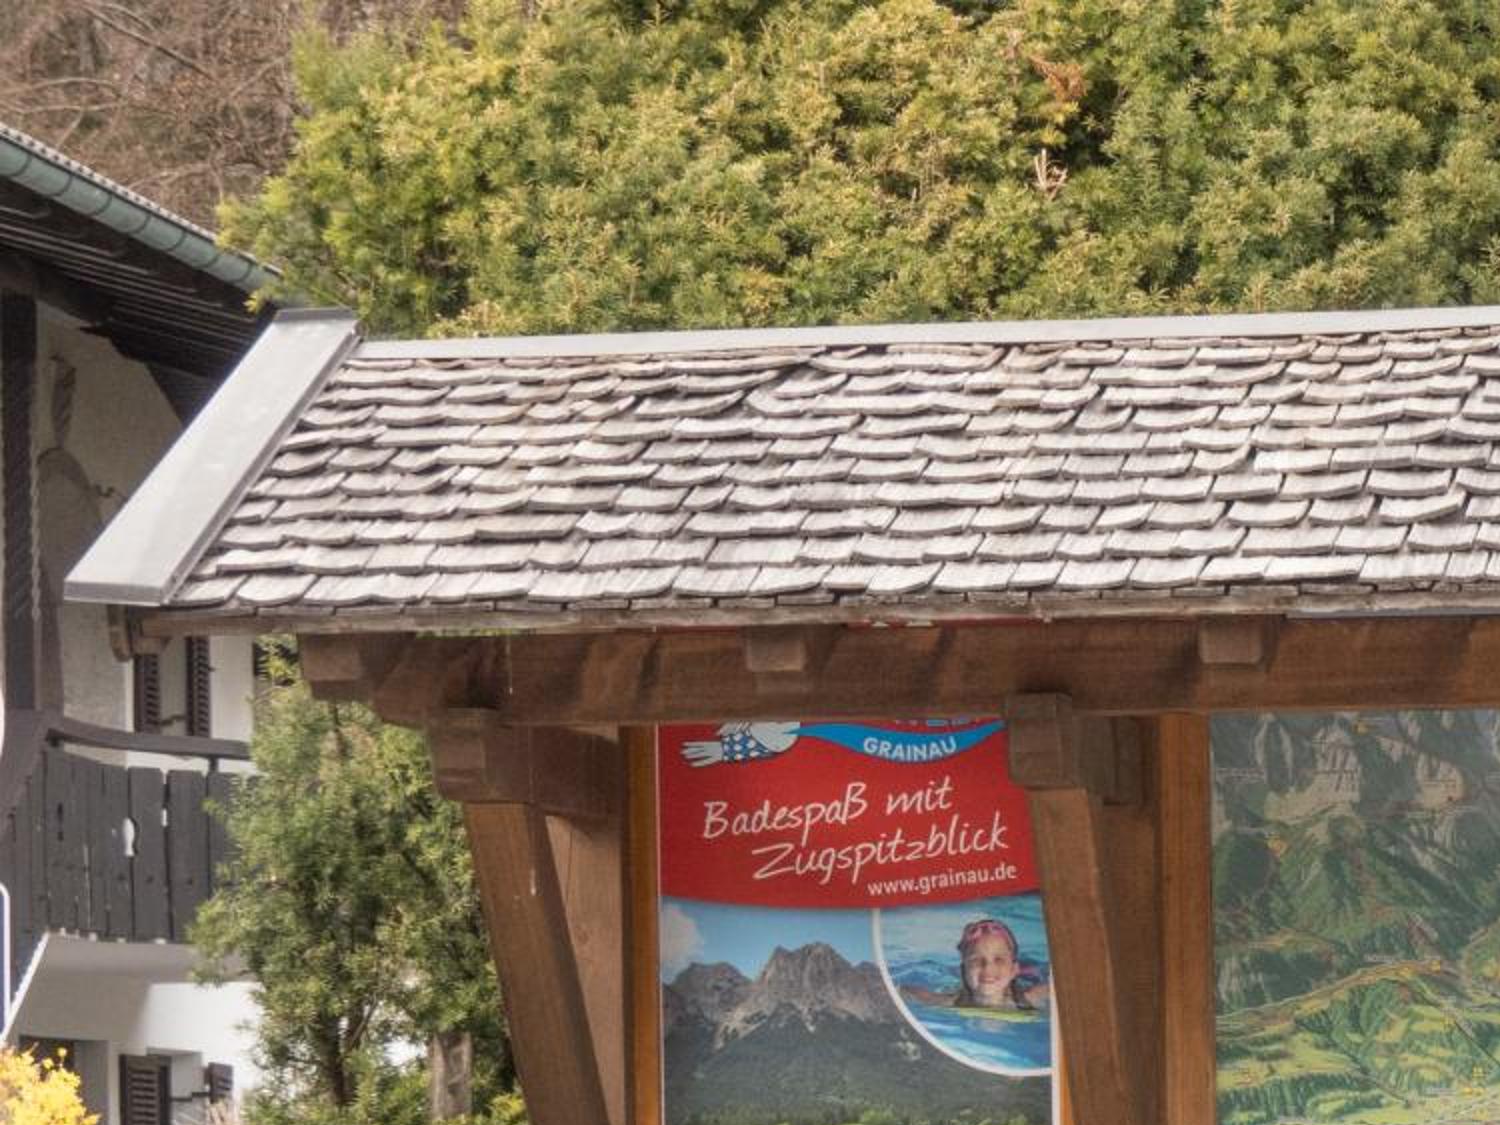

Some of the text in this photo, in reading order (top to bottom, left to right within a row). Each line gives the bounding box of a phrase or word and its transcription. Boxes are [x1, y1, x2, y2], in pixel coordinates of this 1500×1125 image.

[863, 735, 957, 762] GRAINAU
[703, 775, 953, 848] Badespaß mit
[751, 810, 1010, 886] Zugspitzblick
[867, 862, 1018, 896] www.grainau.de
